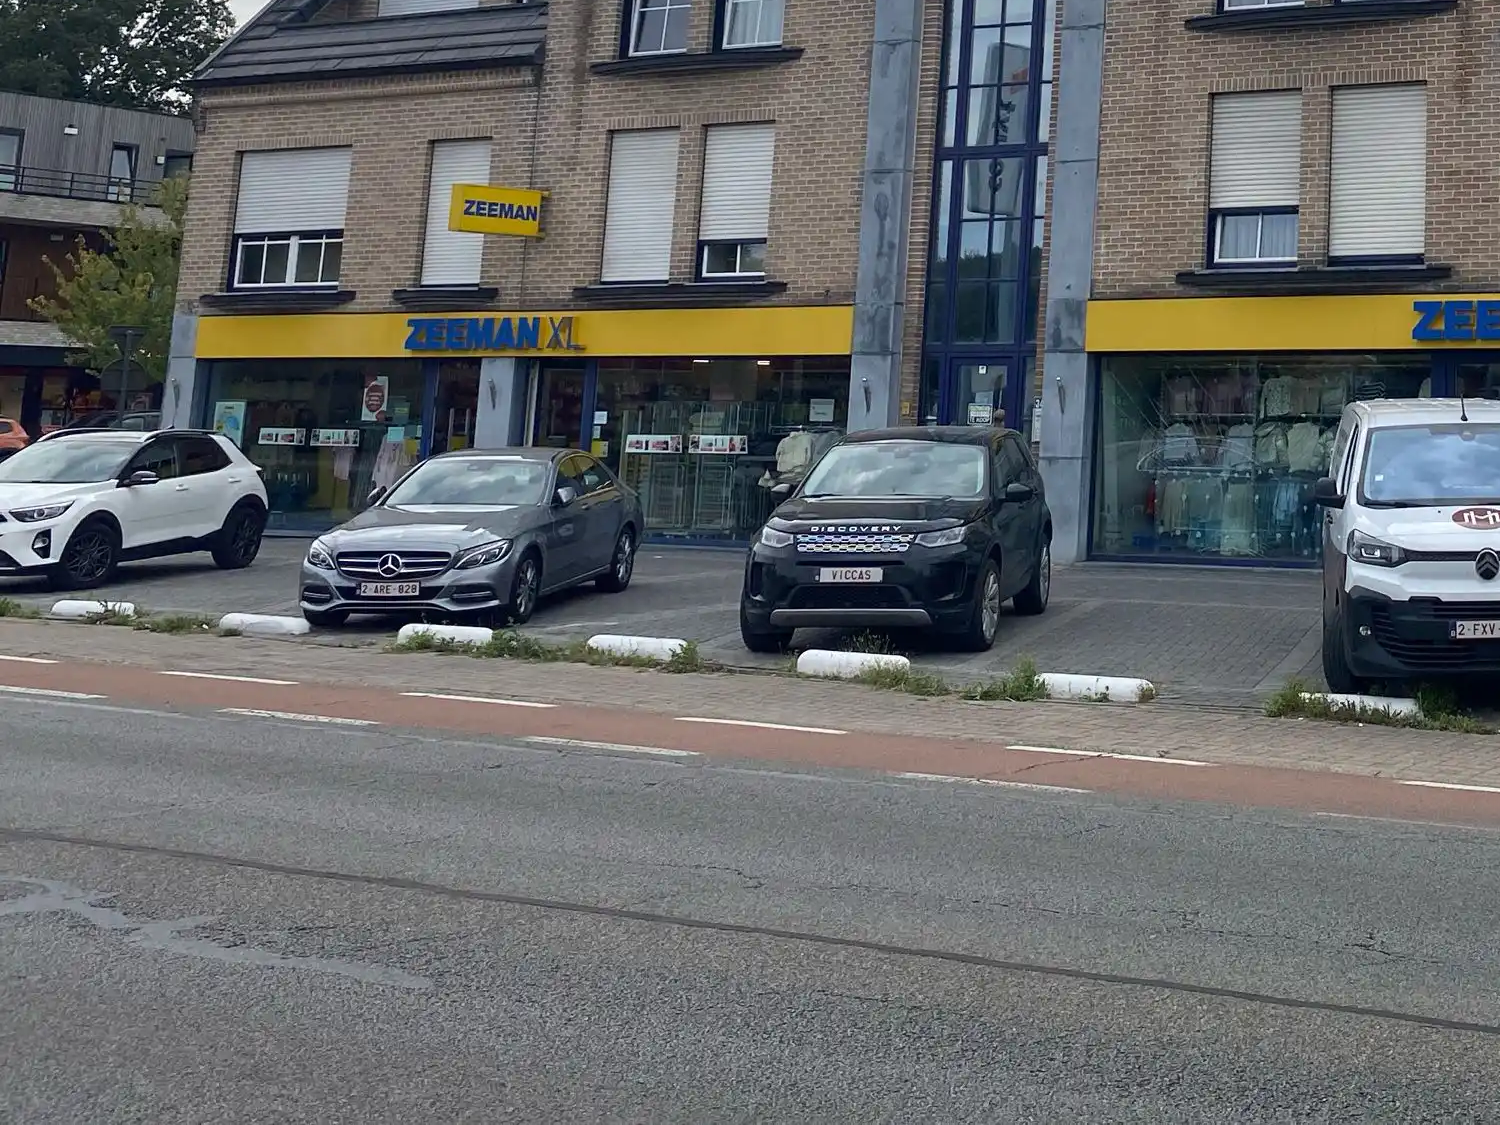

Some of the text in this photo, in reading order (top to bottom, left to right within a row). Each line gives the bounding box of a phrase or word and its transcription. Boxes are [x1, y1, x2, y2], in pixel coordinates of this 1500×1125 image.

[464, 199, 537, 222] ZEEMAN
[404, 316, 586, 351] ZEEMAN XL
[831, 569, 872, 580] VICCAS
